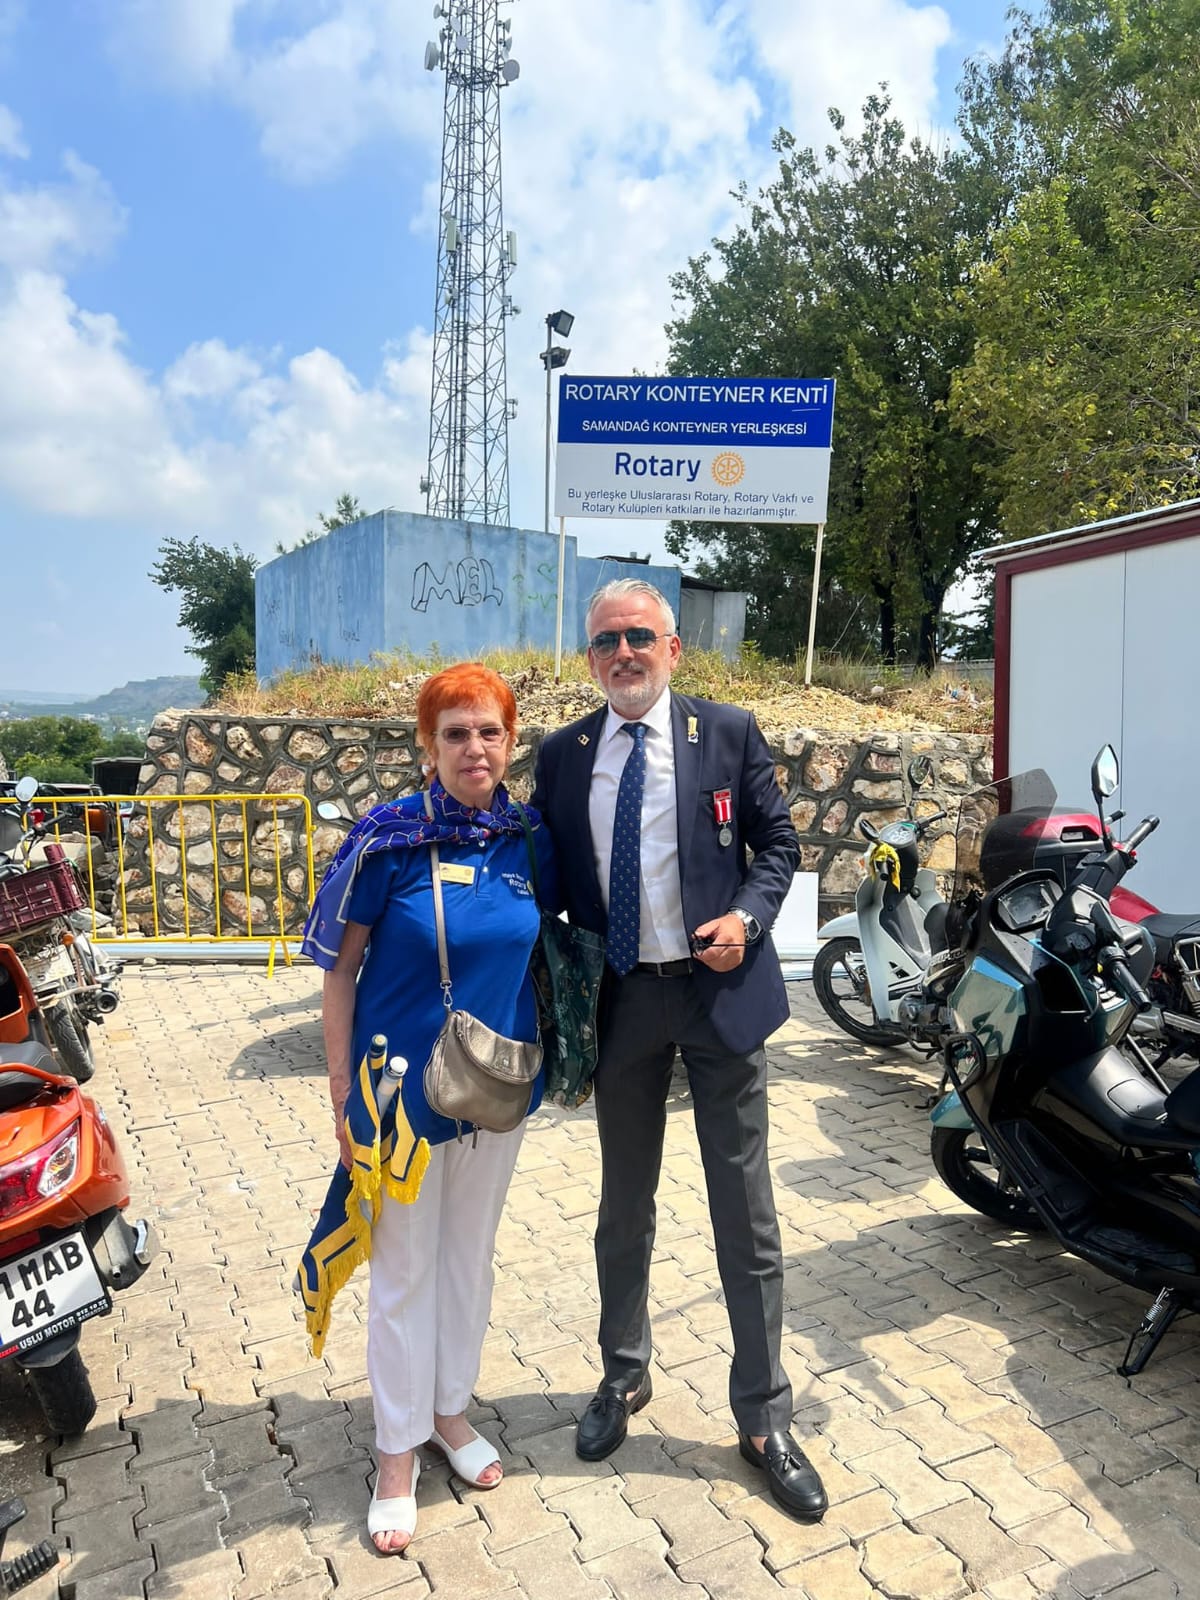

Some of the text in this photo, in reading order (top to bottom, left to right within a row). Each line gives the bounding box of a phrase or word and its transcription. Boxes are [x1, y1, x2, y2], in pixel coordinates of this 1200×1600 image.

[565, 384, 828, 404] ROTARY KONTEYNER KENTİ
[582, 419, 807, 437] SAMANDAĞ KONTEYNER YERLEŞKESİ
[615, 452, 701, 482] Rotary
[568, 488, 814, 505] Bu yerleşke Uluslararası Rotary, Rotary Vakfı ve
[582, 502, 798, 519] Rotary Kulüpleri katkıları ile hazırlanmıştır.
[17, 1241, 83, 1291] MAB
[12, 1289, 55, 1328] 44
[19, 1316, 76, 1349] USLU MOTOR
